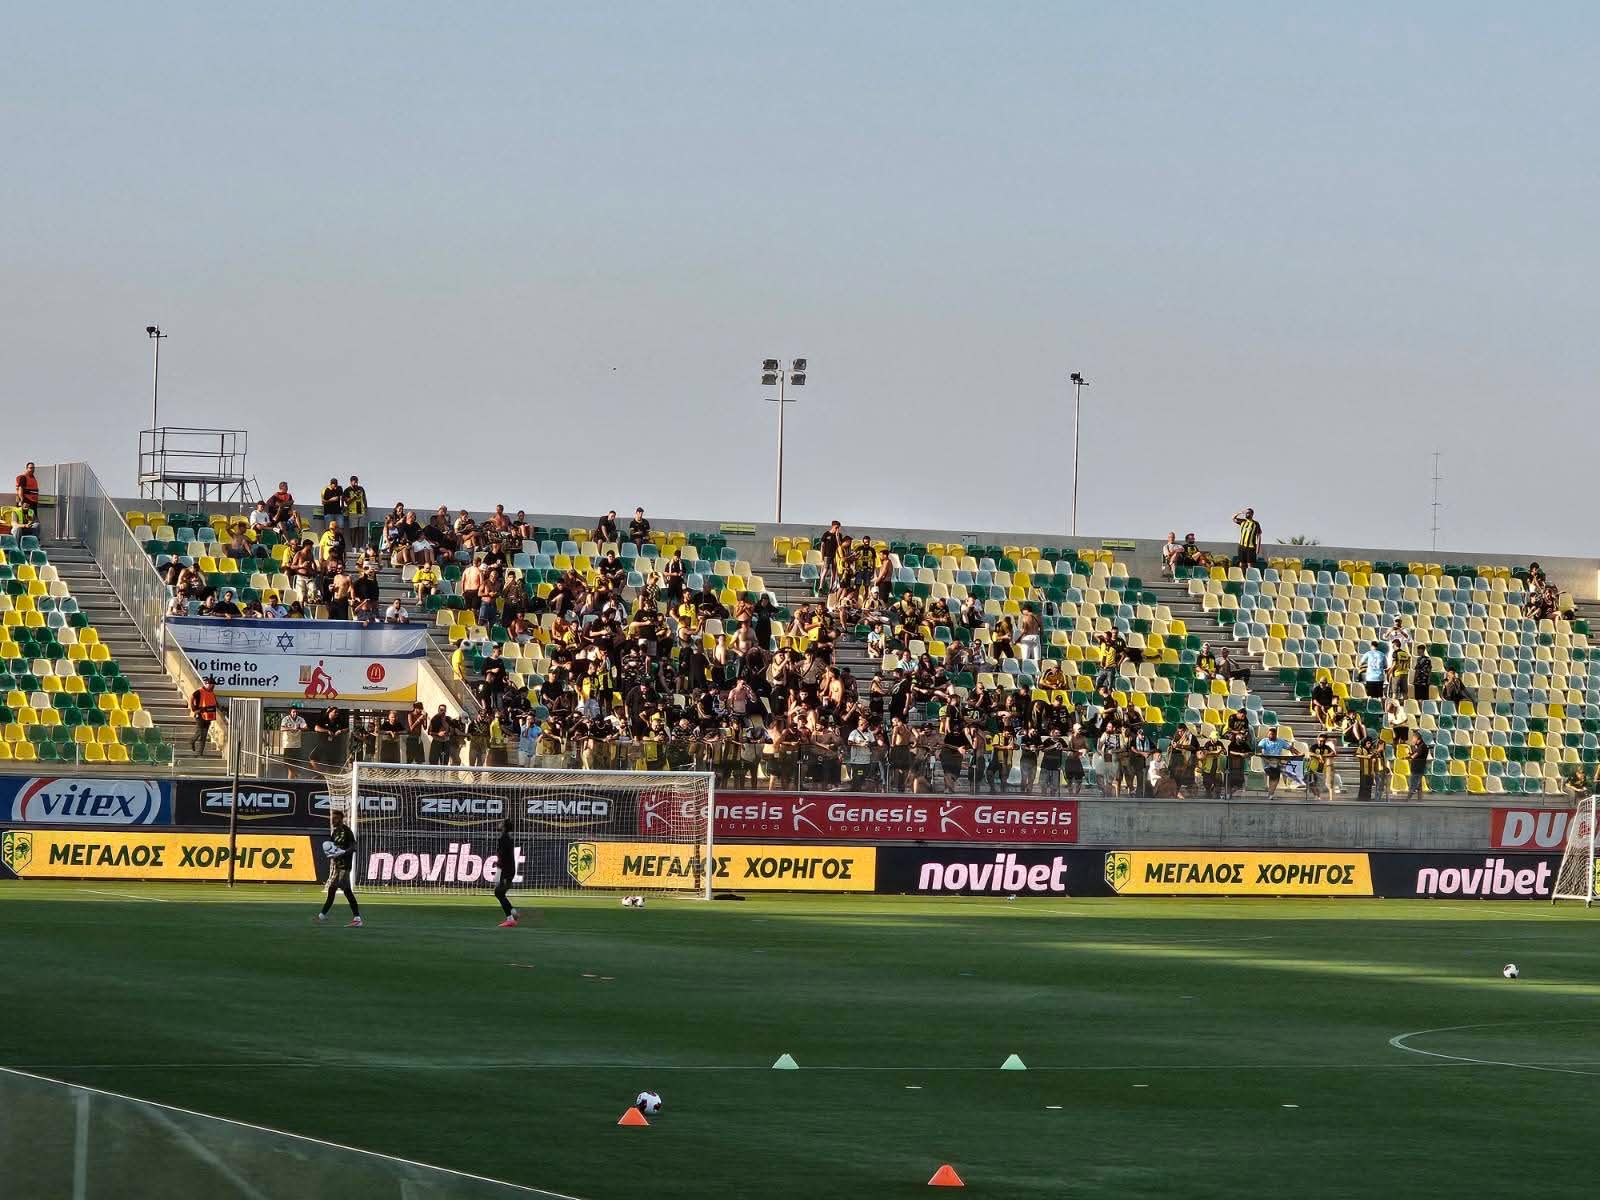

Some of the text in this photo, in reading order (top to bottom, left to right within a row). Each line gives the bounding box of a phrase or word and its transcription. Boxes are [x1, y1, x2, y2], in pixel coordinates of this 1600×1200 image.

[210, 659, 241, 671] time
[244, 660, 258, 671] to
[202, 673, 279, 686] ake dinner?
[40, 784, 136, 817] vitex
[206, 792, 290, 808] ZEMCO
[314, 795, 397, 811] ZEMCO
[421, 798, 503, 814] ZEMCO
[527, 800, 608, 815] ZEMCO
[681, 801, 783, 820] Genesis
[827, 803, 928, 823] Genesis
[974, 805, 1072, 825] Genesis
[49, 844, 295, 869] ΜΕΓΑΛΟΣ ΧΟΡΗΓΟΣ
[367, 843, 526, 883] novibet
[622, 856, 854, 879] ΜΕΓΑΛΟΣ ΧΟΡΗΓΟΣ
[918, 853, 1068, 892] novibet
[1144, 863, 1355, 885] ΜΕΓΑΛΟΣ ΧΟΡΗΓΟΣ
[1416, 858, 1551, 895] novibet
